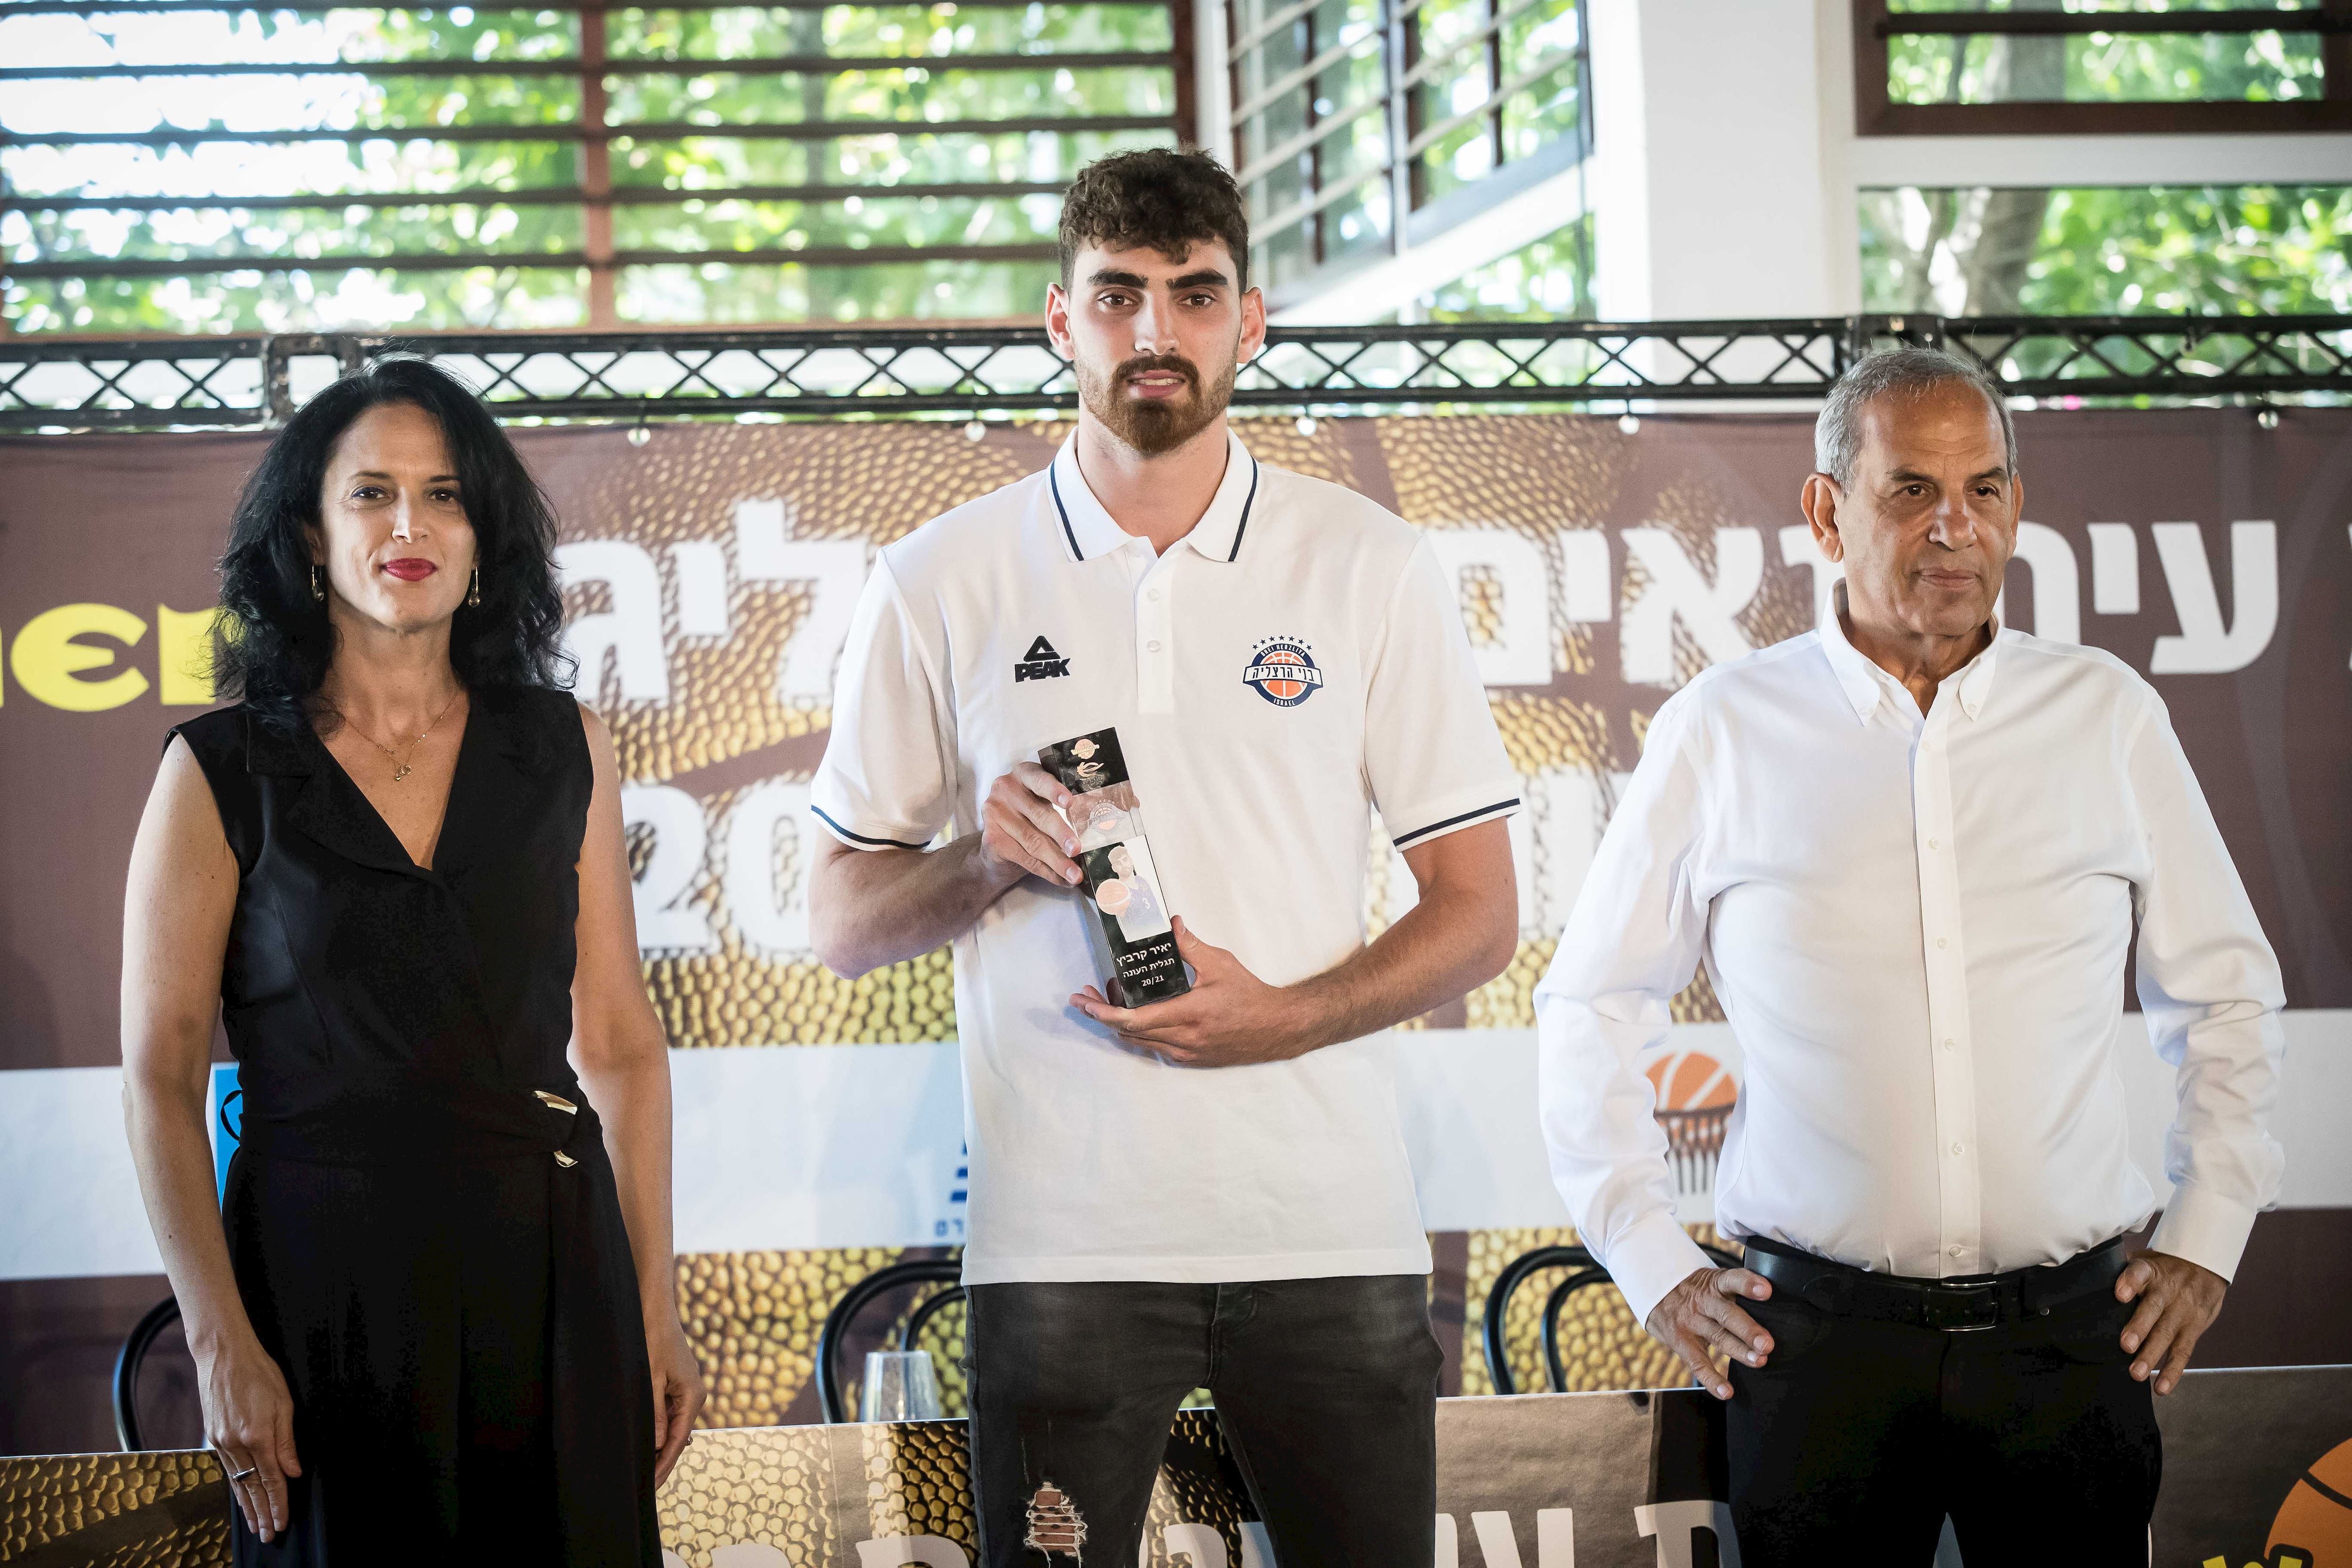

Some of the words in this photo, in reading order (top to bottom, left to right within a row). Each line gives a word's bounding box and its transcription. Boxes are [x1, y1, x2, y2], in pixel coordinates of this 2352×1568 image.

[553, 498, 866, 700] ליג
[1276, 644, 1305, 657] HERZLIYA
[1015, 658, 1071, 683] PEAK
[1252, 666, 1293, 679] הרצליה
[1298, 668, 1314, 682] בני
[1149, 942, 1172, 955] יאיר
[1116, 950, 1147, 967] קרביץ
[1149, 958, 1175, 971] תגלית
[1122, 966, 1148, 978] העונה
[1141, 975, 1164, 987] 20/21
